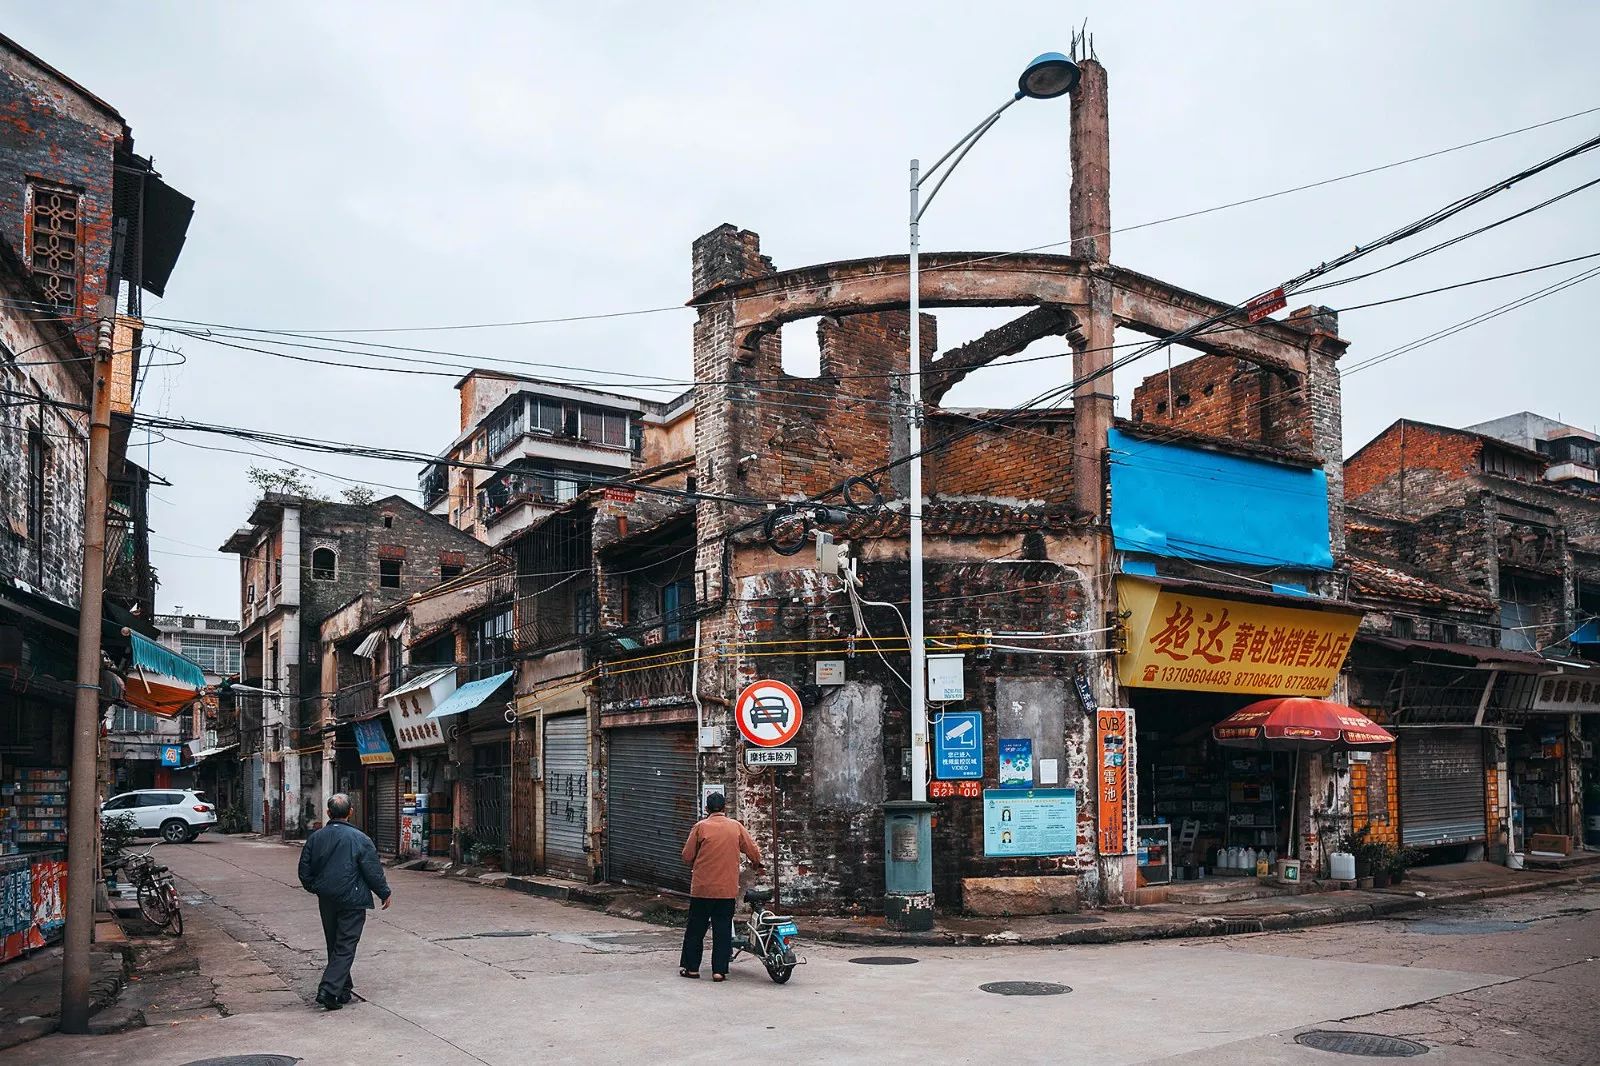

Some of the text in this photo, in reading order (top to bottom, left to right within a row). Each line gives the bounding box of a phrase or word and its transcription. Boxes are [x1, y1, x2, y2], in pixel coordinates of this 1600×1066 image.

[1161, 666, 1330, 691] 13709604483 87708420 87728244
[750, 751, 793, 762] 摩托车除外
[1103, 769, 1118, 802] 電池
